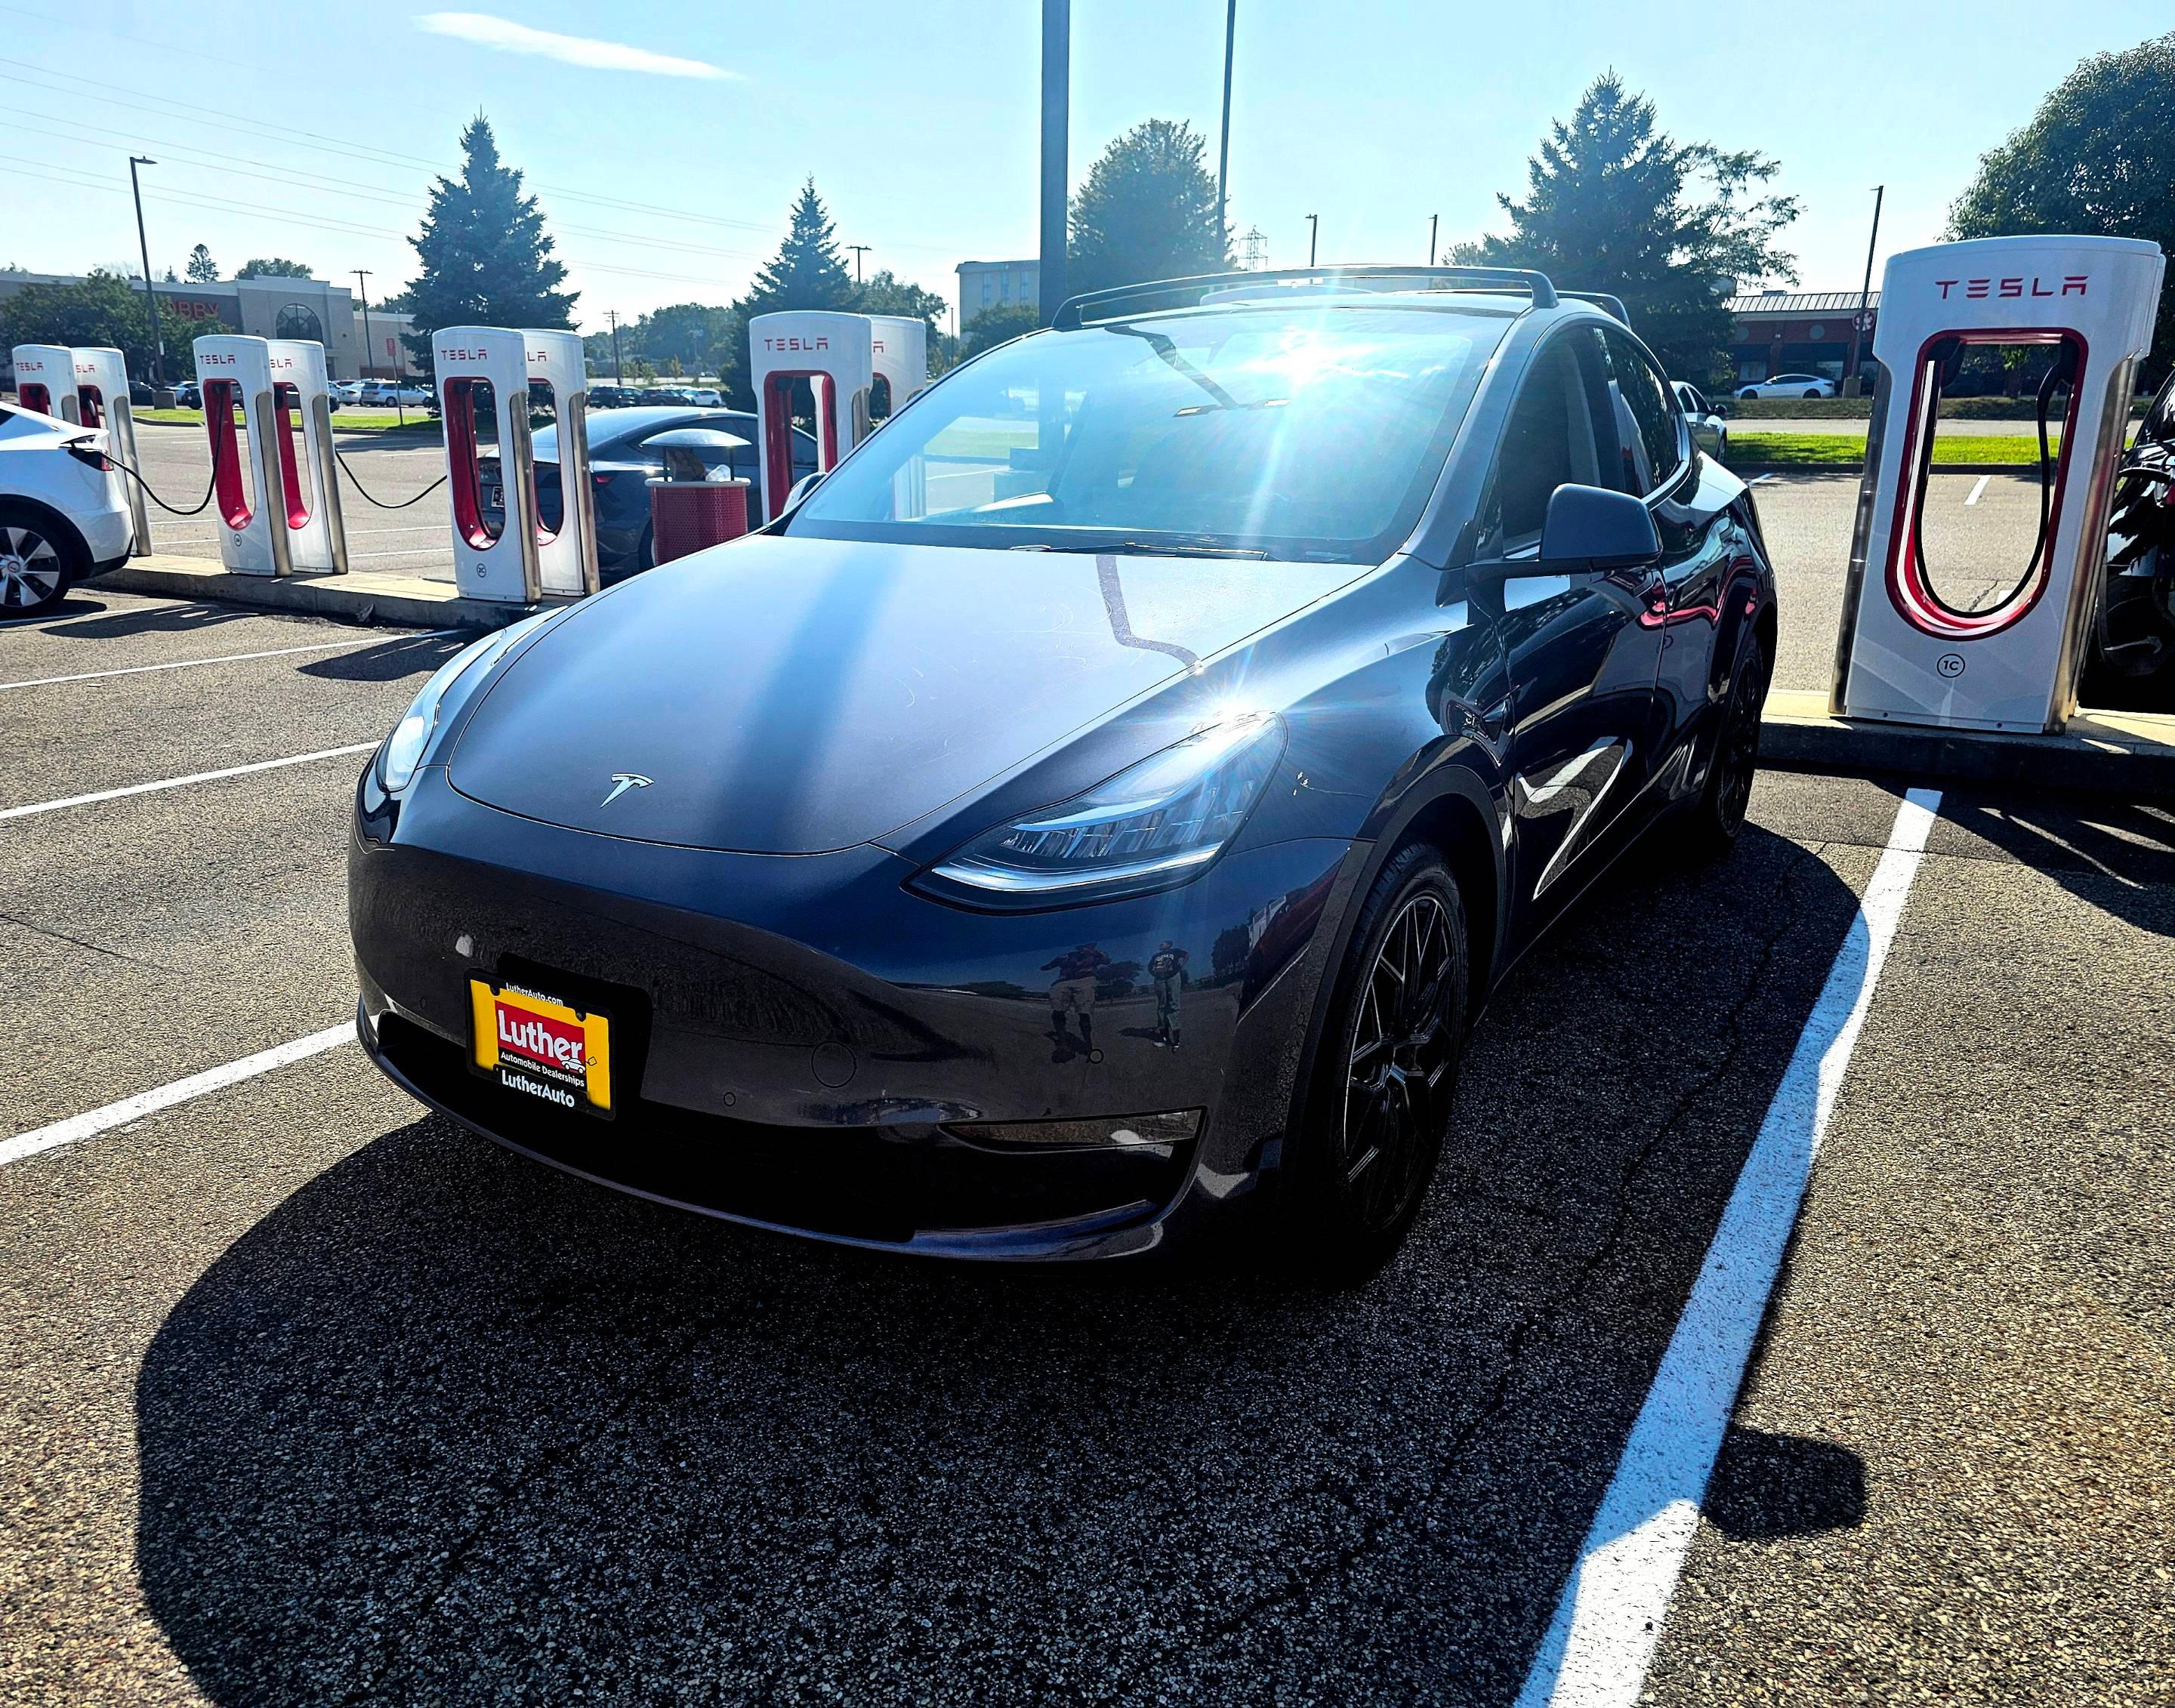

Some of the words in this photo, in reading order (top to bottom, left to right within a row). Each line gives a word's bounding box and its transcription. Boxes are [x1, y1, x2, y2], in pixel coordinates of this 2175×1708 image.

[1935, 276, 2089, 300] TESLA
[764, 338, 828, 351] TESLA
[199, 354, 236, 365] TESLA
[441, 349, 487, 360] TESLA
[16, 362, 44, 372] TESLA
[76, 365, 95, 373] SLA
[270, 359, 292, 368] SLA
[1943, 660, 1960, 671] 1C
[505, 982, 563, 1007] LutherAuto.com
[498, 1009, 583, 1062] Luther
[500, 1051, 541, 1073] Automobile
[541, 1068, 585, 1088] Dealerships
[501, 1069, 575, 1108] LutherAuto
